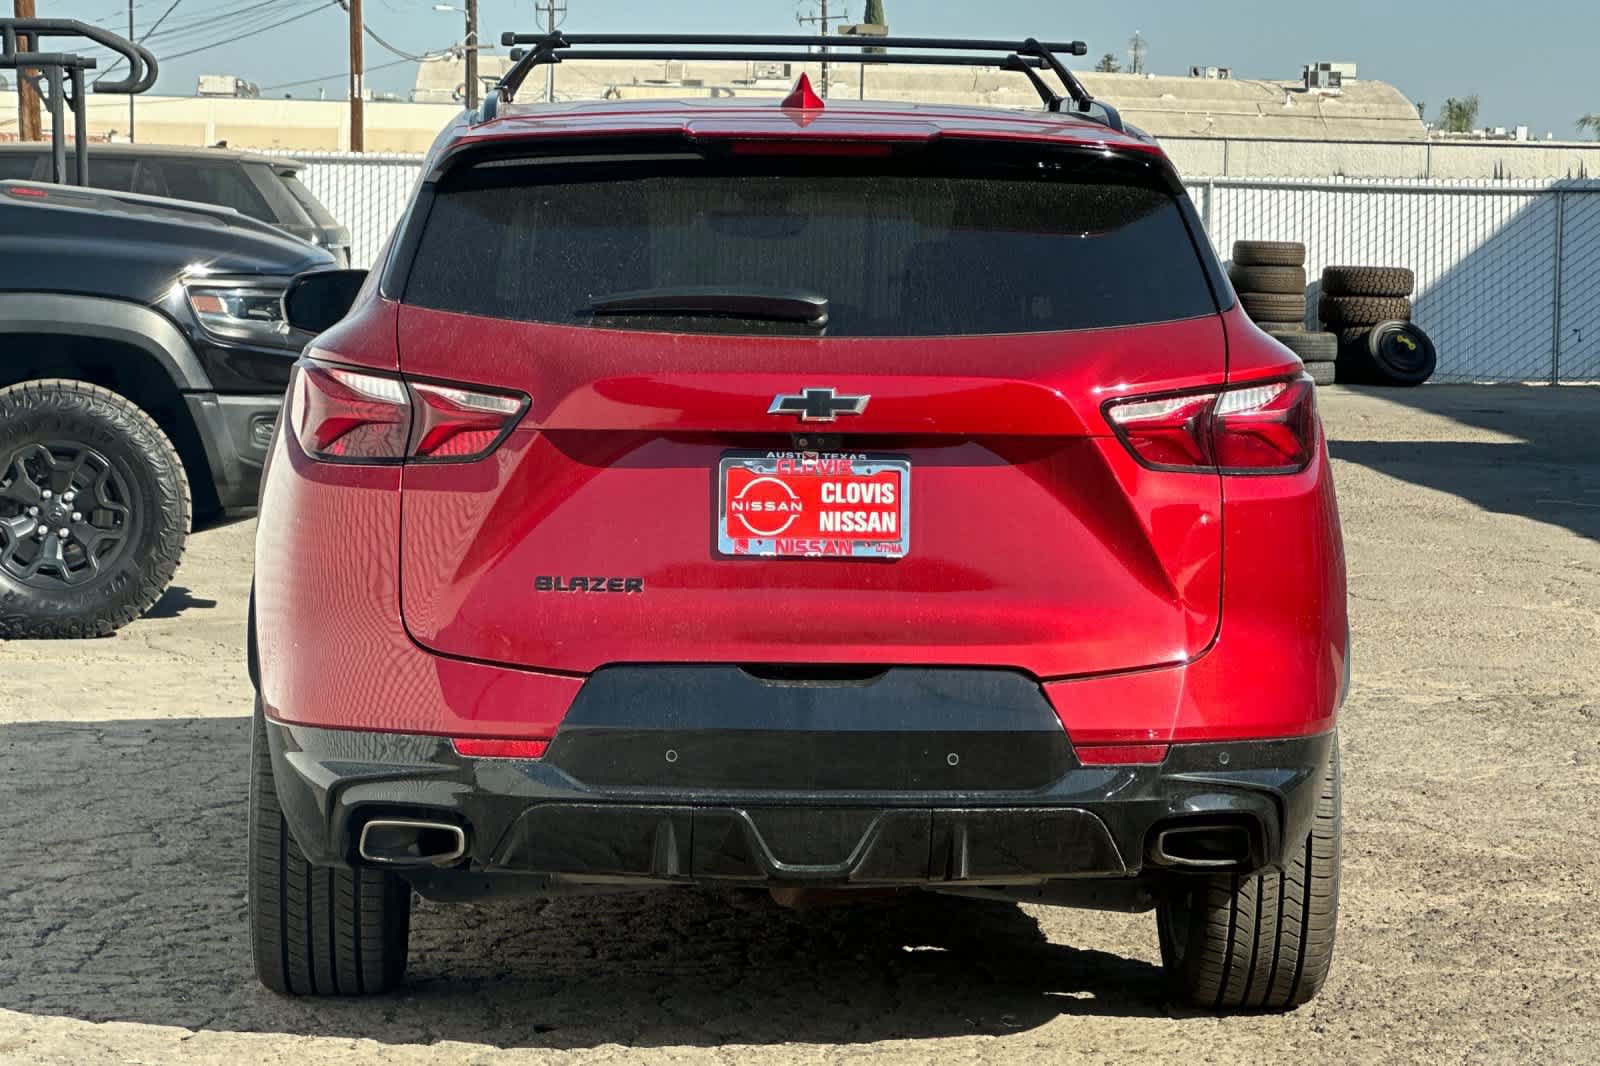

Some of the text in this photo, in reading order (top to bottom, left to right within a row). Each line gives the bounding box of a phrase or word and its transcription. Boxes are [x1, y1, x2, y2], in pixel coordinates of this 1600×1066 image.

[821, 482, 895, 504] CLOVIS
[731, 501, 803, 512] NISSAN
[819, 511, 896, 532] NISSAN
[774, 539, 853, 556] NISSAN
[535, 576, 643, 592] BLAZER
